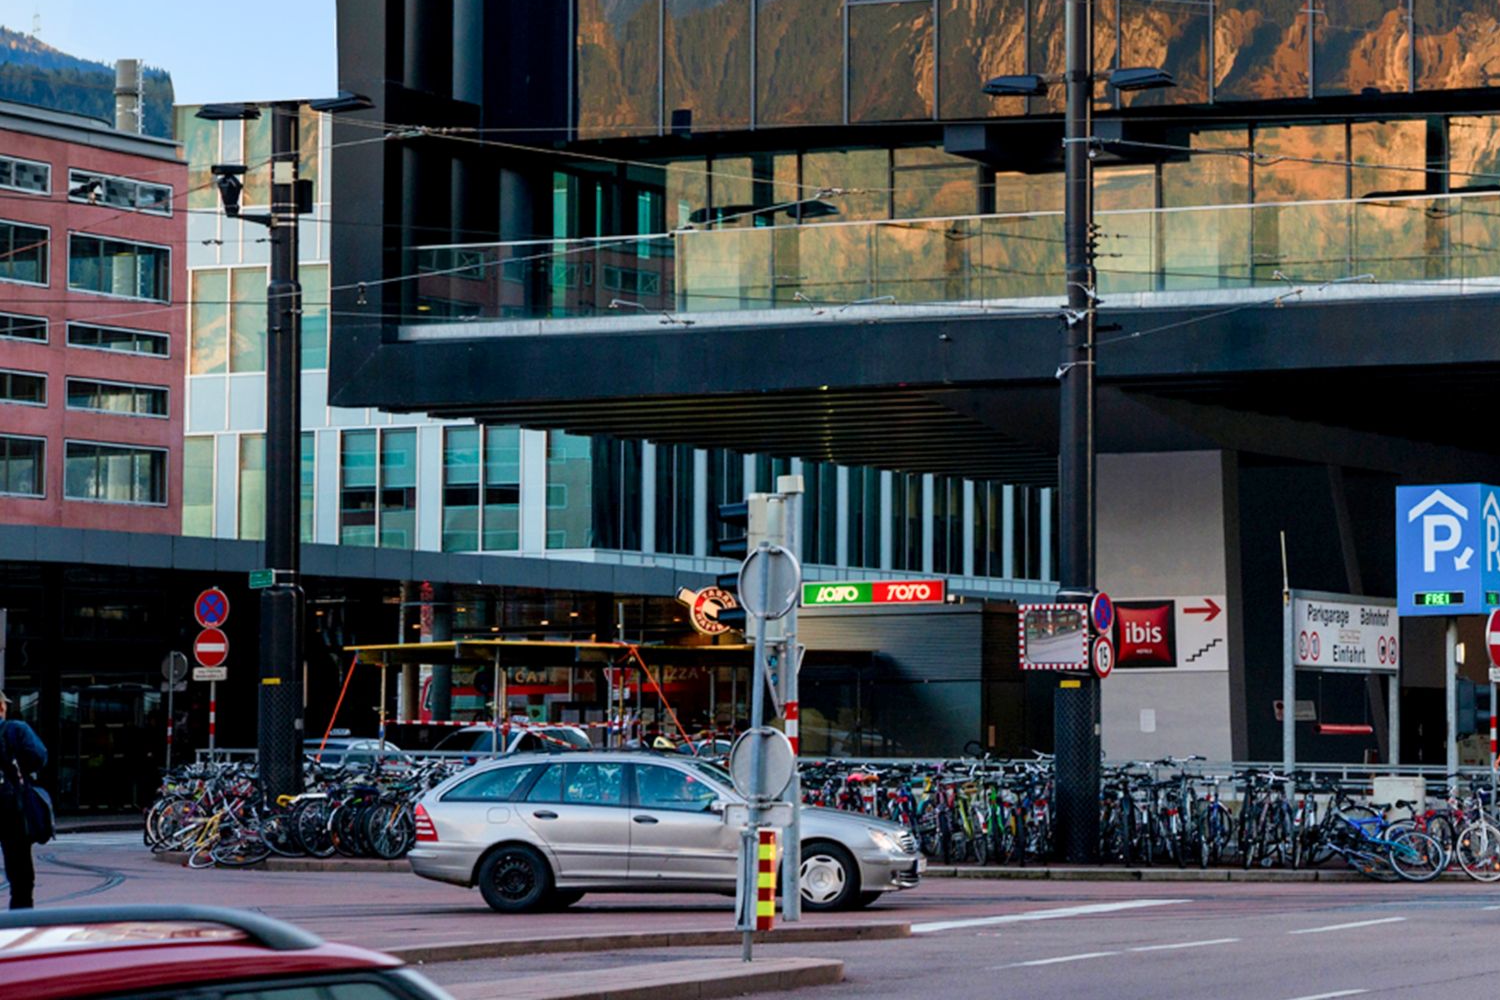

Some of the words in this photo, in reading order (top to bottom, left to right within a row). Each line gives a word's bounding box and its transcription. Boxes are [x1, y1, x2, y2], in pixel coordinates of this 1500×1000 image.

[1423, 514, 1462, 573] P
[1486, 514, 1499, 572] P
[816, 586, 859, 603] LOTTO
[887, 584, 931, 601] TOTO
[1424, 593, 1451, 606] FREI
[1307, 603, 1350, 628] Parkgarage
[1360, 607, 1390, 627] Bahnhof
[1125, 621, 1163, 644] ibis
[1099, 646, 1108, 668] 15
[1333, 644, 1366, 664] Einfahrt
